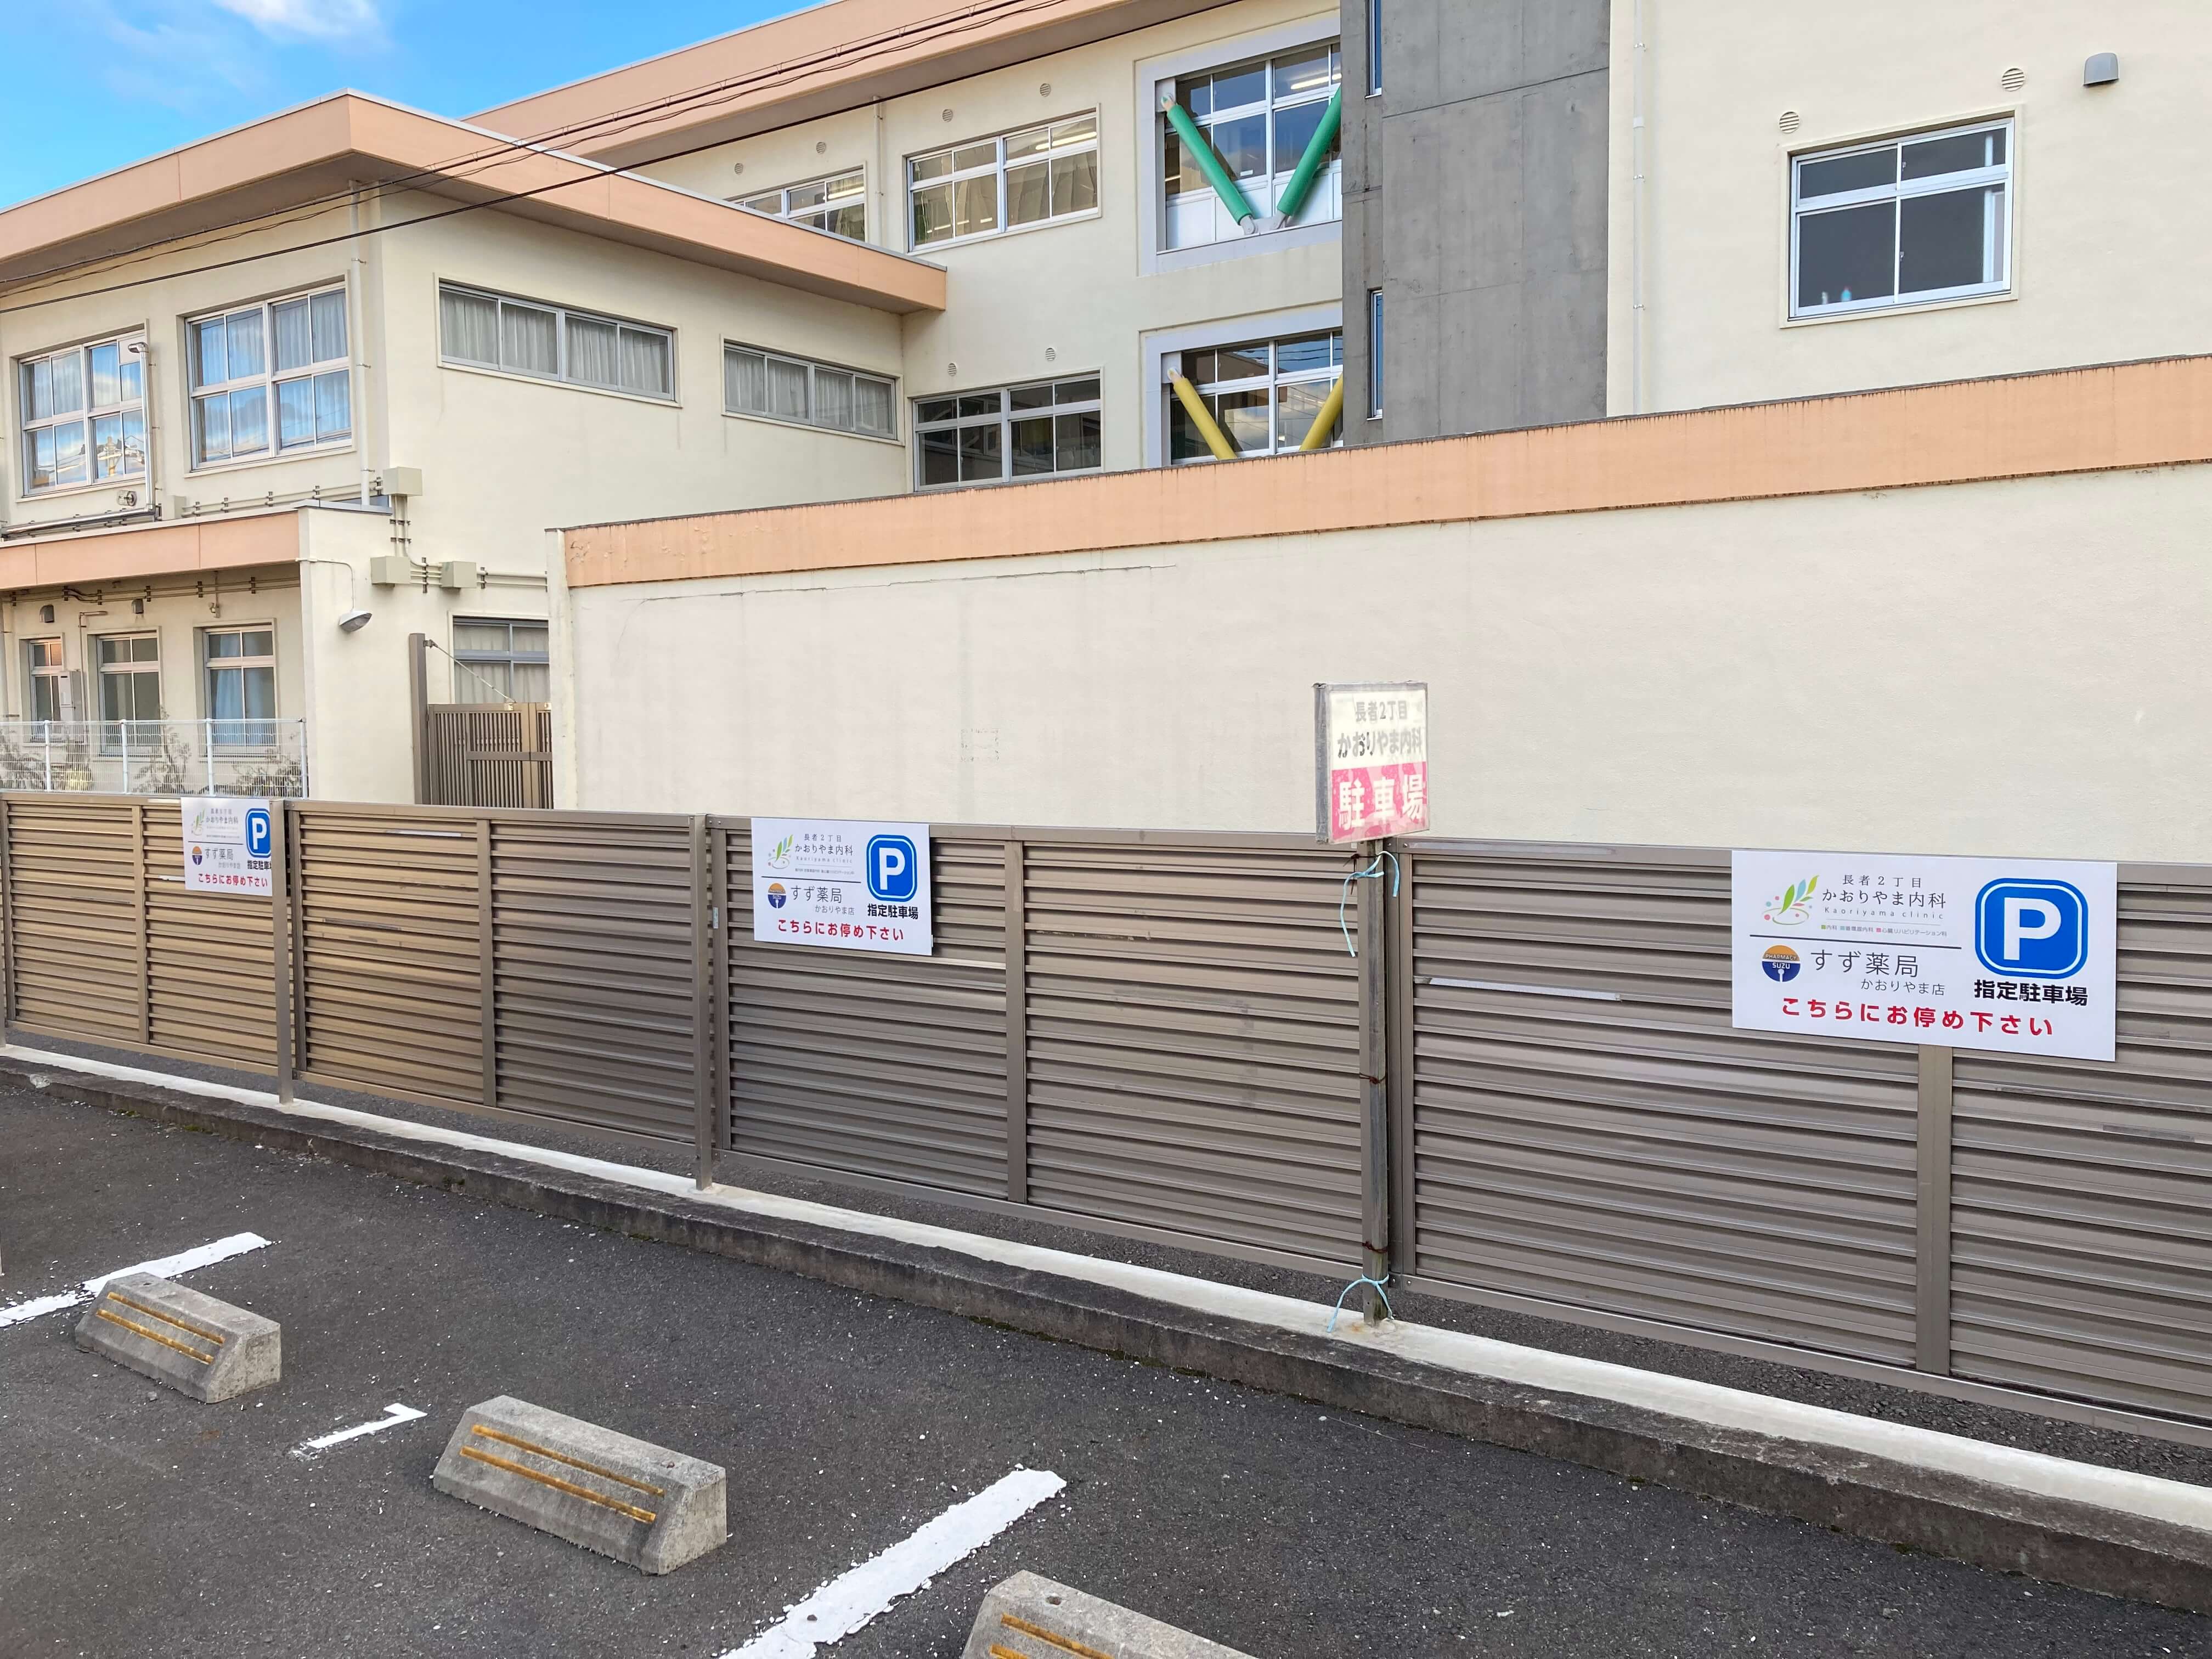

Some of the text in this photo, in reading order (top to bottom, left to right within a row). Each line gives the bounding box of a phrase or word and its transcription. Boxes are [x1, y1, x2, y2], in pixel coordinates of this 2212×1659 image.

[1356, 701, 1408, 722] 長者2丁目
[1338, 728, 1423, 758] かおりやま内科
[1338, 774, 1424, 830] 駐車場
[795, 844, 853, 856] かおりやま内科
[199, 873, 268, 887] こちらにお停め下さい
[1842, 874, 1921, 888] 長者2丁目
[791, 885, 842, 903] すず薬局
[1822, 889, 1946, 909] かおりやま内科
[815, 904, 855, 915] かおりやま店
[867, 903, 918, 919] 指定駐車場
[1825, 907, 1895, 917] Kaoriyama
[778, 919, 904, 940] こちらにお停め下さい
[1811, 950, 1918, 977] すず薬局
[1861, 978, 1945, 996] かおりやま店
[1974, 979, 2089, 1006] 指定駐車場
[1782, 997, 2053, 1036] こちらにお停め下さい
